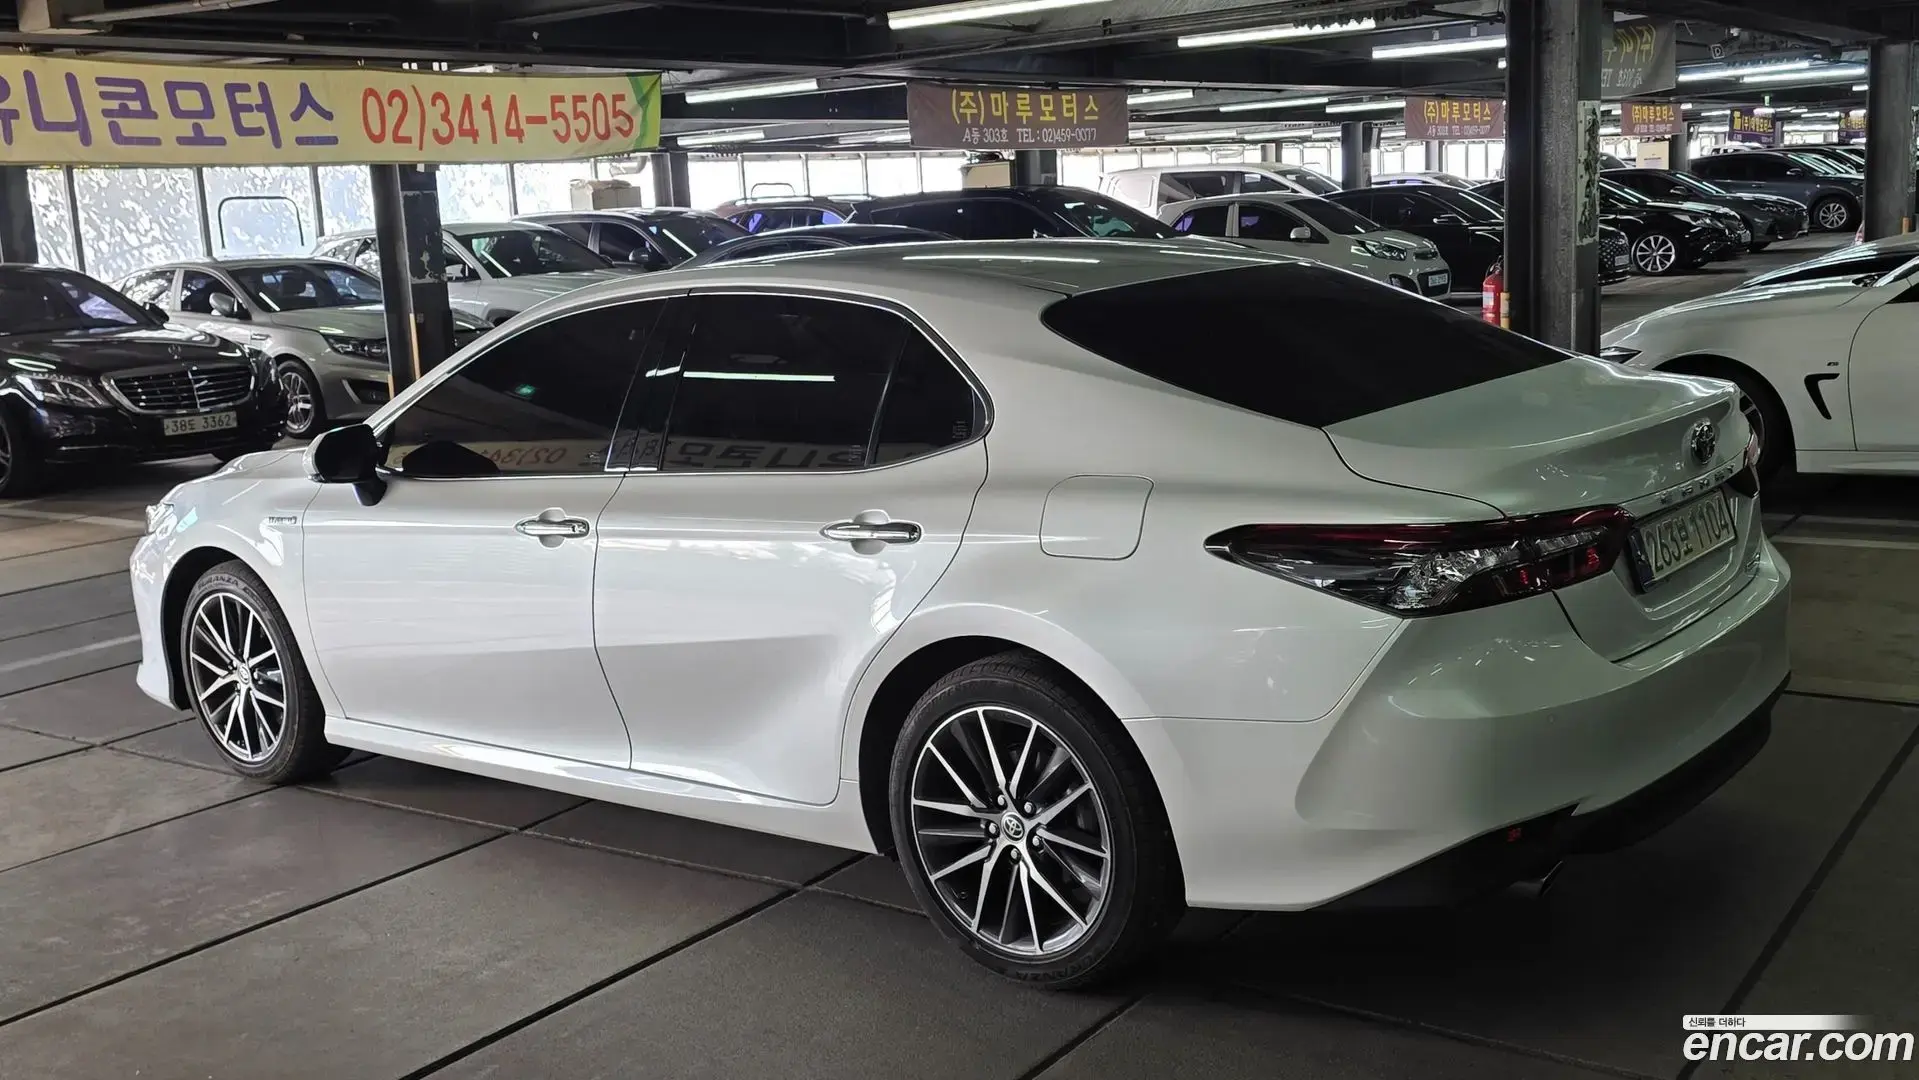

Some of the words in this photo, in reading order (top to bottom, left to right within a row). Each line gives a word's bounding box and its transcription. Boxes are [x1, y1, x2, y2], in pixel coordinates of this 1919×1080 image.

[362, 84, 634, 151] 02)3414-5505
[952, 88, 1099, 125] (주)마루모터스
[1424, 100, 1491, 124] (주)마루모터스
[963, 127, 981, 145] A동
[983, 127, 1009, 143] 303호
[201, 414, 233, 429] 3362
